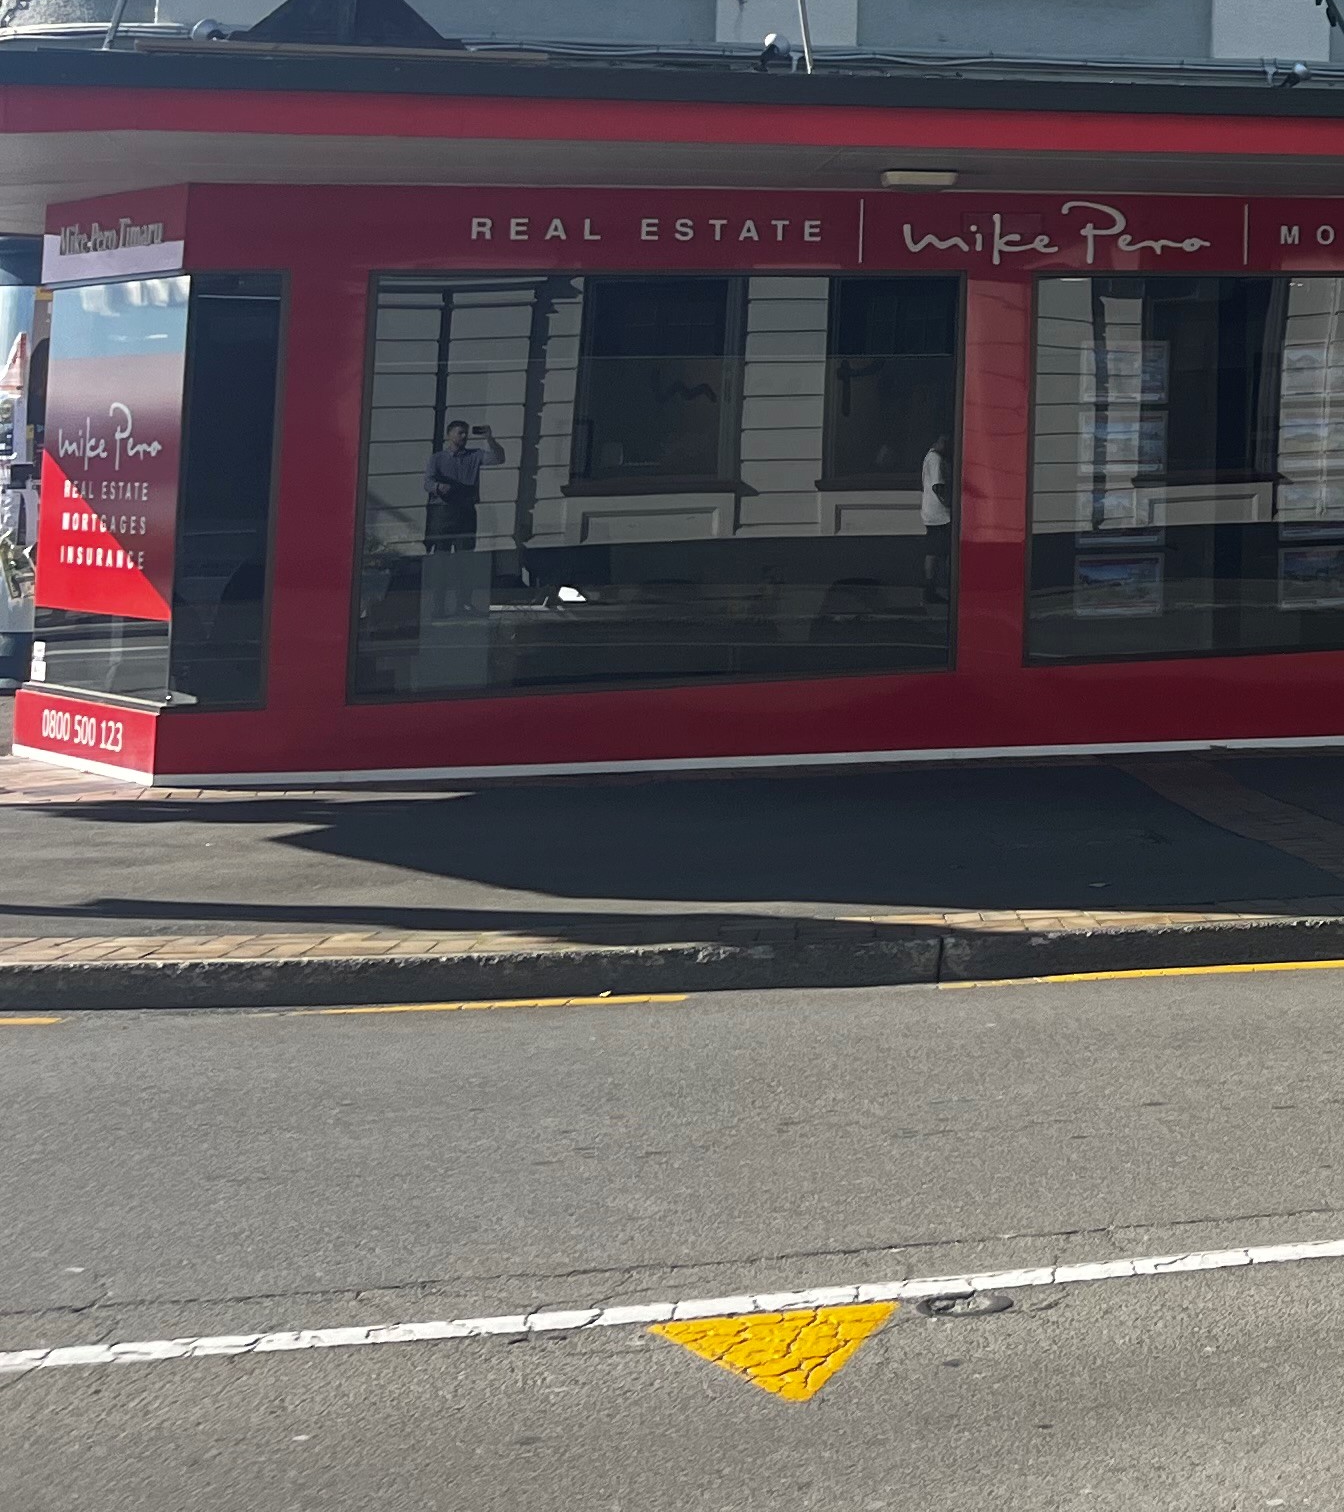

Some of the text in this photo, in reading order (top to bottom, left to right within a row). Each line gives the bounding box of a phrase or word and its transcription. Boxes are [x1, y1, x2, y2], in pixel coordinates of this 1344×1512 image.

[471, 217, 601, 241] REAL
[640, 218, 823, 242] ESTATE
[903, 213, 1058, 265] mike
[1061, 201, 1211, 264] Pero
[59, 402, 163, 472] mike Pero
[64, 479, 149, 501] REAL ESTATE
[62, 512, 147, 535] MORTGAGES
[60, 545, 145, 570] INSURANCE
[41, 708, 124, 753] 0800 500 123
